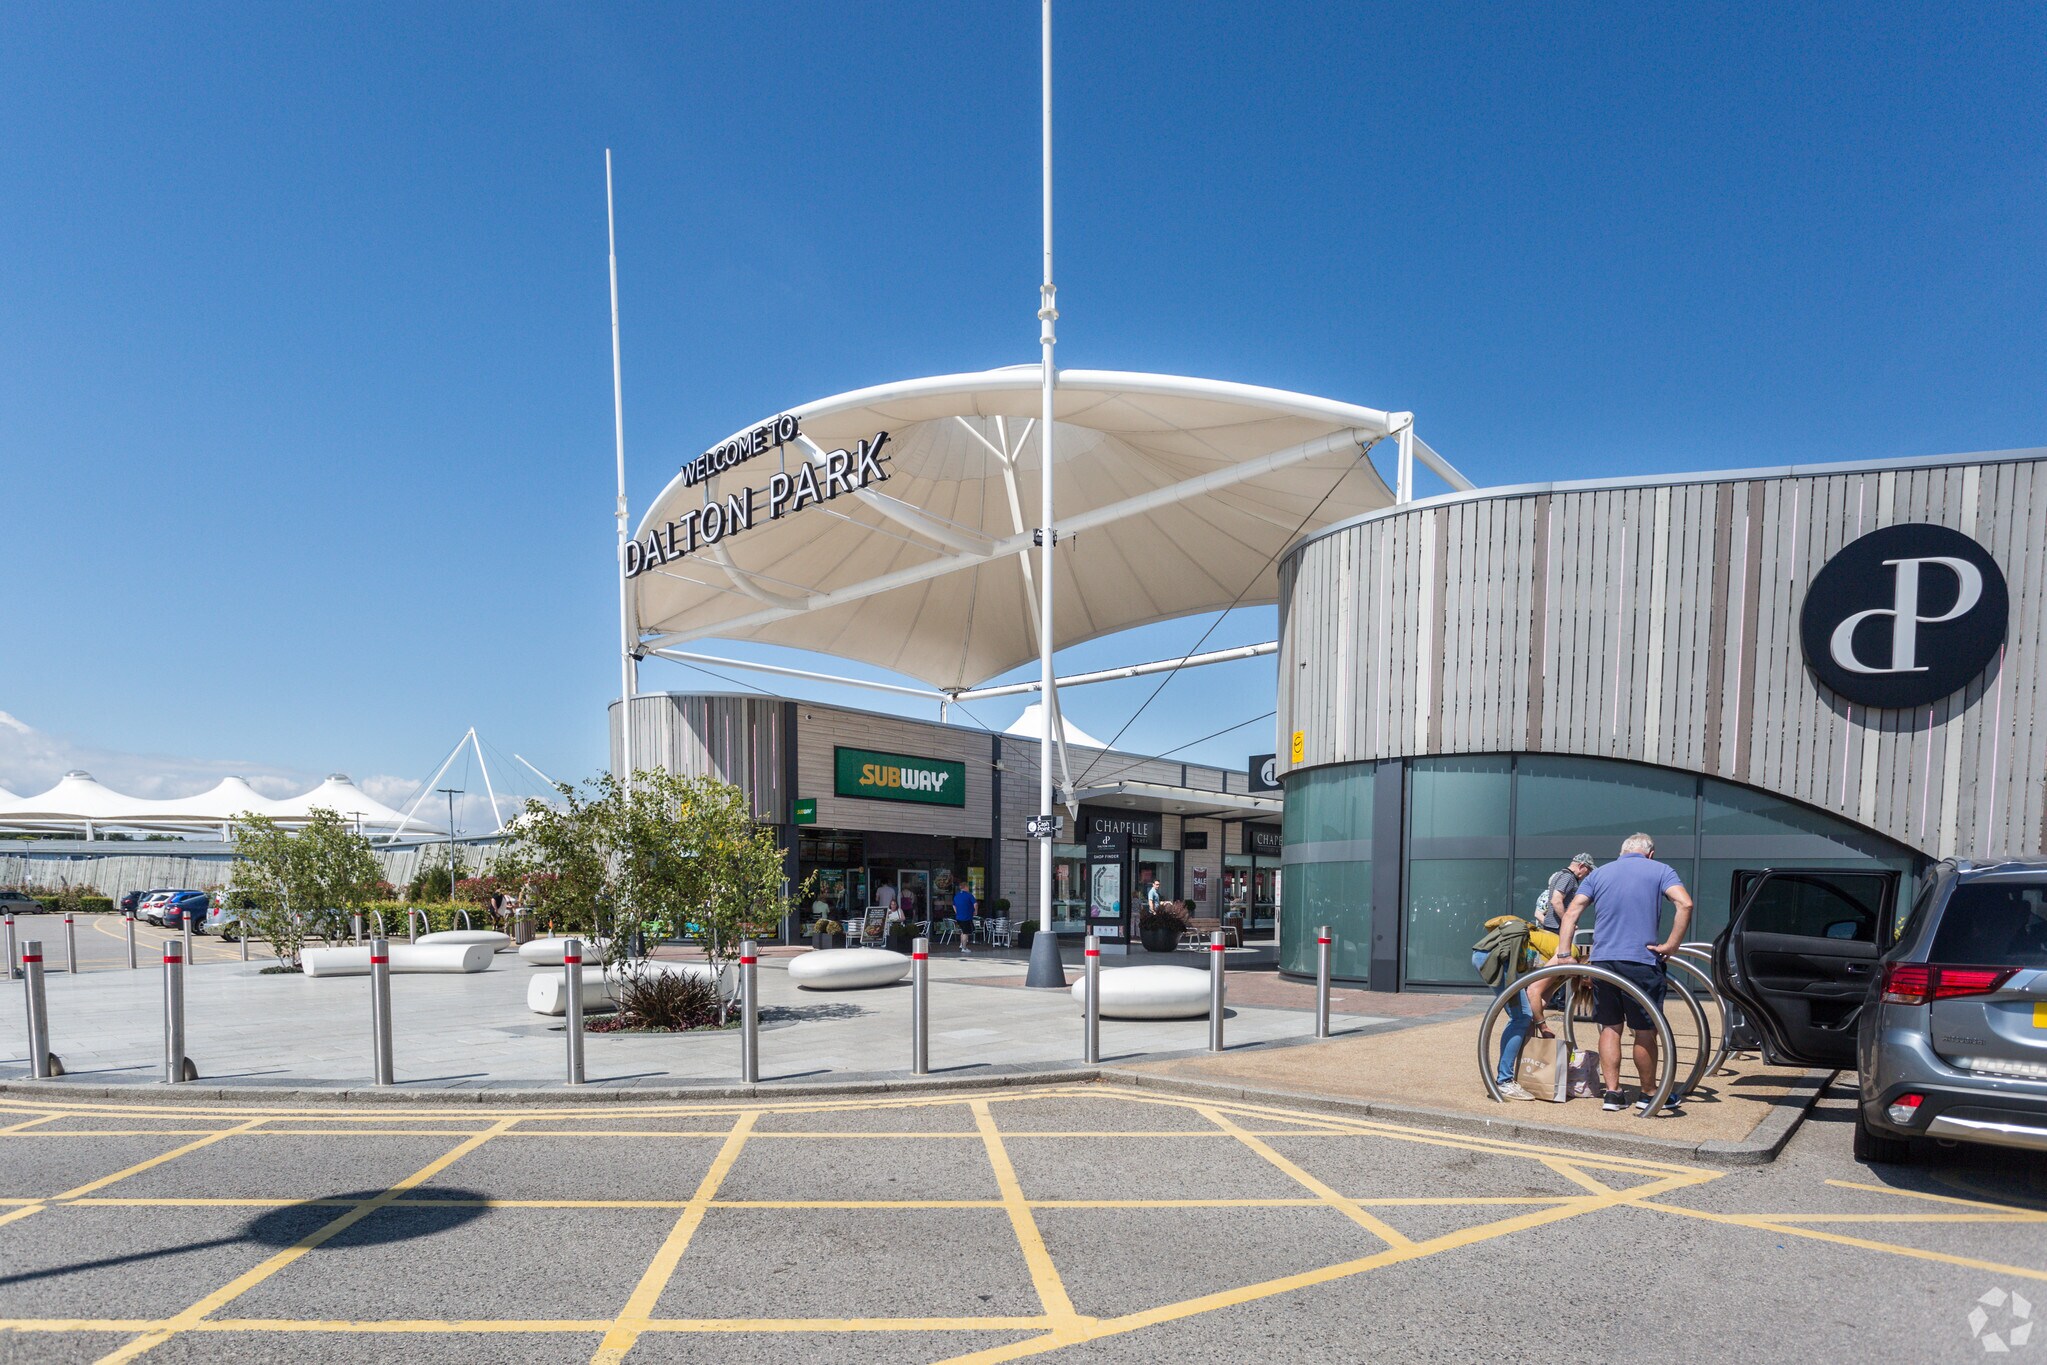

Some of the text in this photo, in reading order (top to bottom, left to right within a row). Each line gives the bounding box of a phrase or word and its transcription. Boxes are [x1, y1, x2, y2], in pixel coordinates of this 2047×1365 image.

[681, 415, 798, 487] WELCOME TO
[625, 431, 888, 578] DALTON PARK
[859, 763, 949, 792] SUBWAY
[1095, 819, 1148, 835] CHAPELLE
[1194, 877, 1207, 885] SALE
[1520, 1057, 1546, 1069] ATFACE
